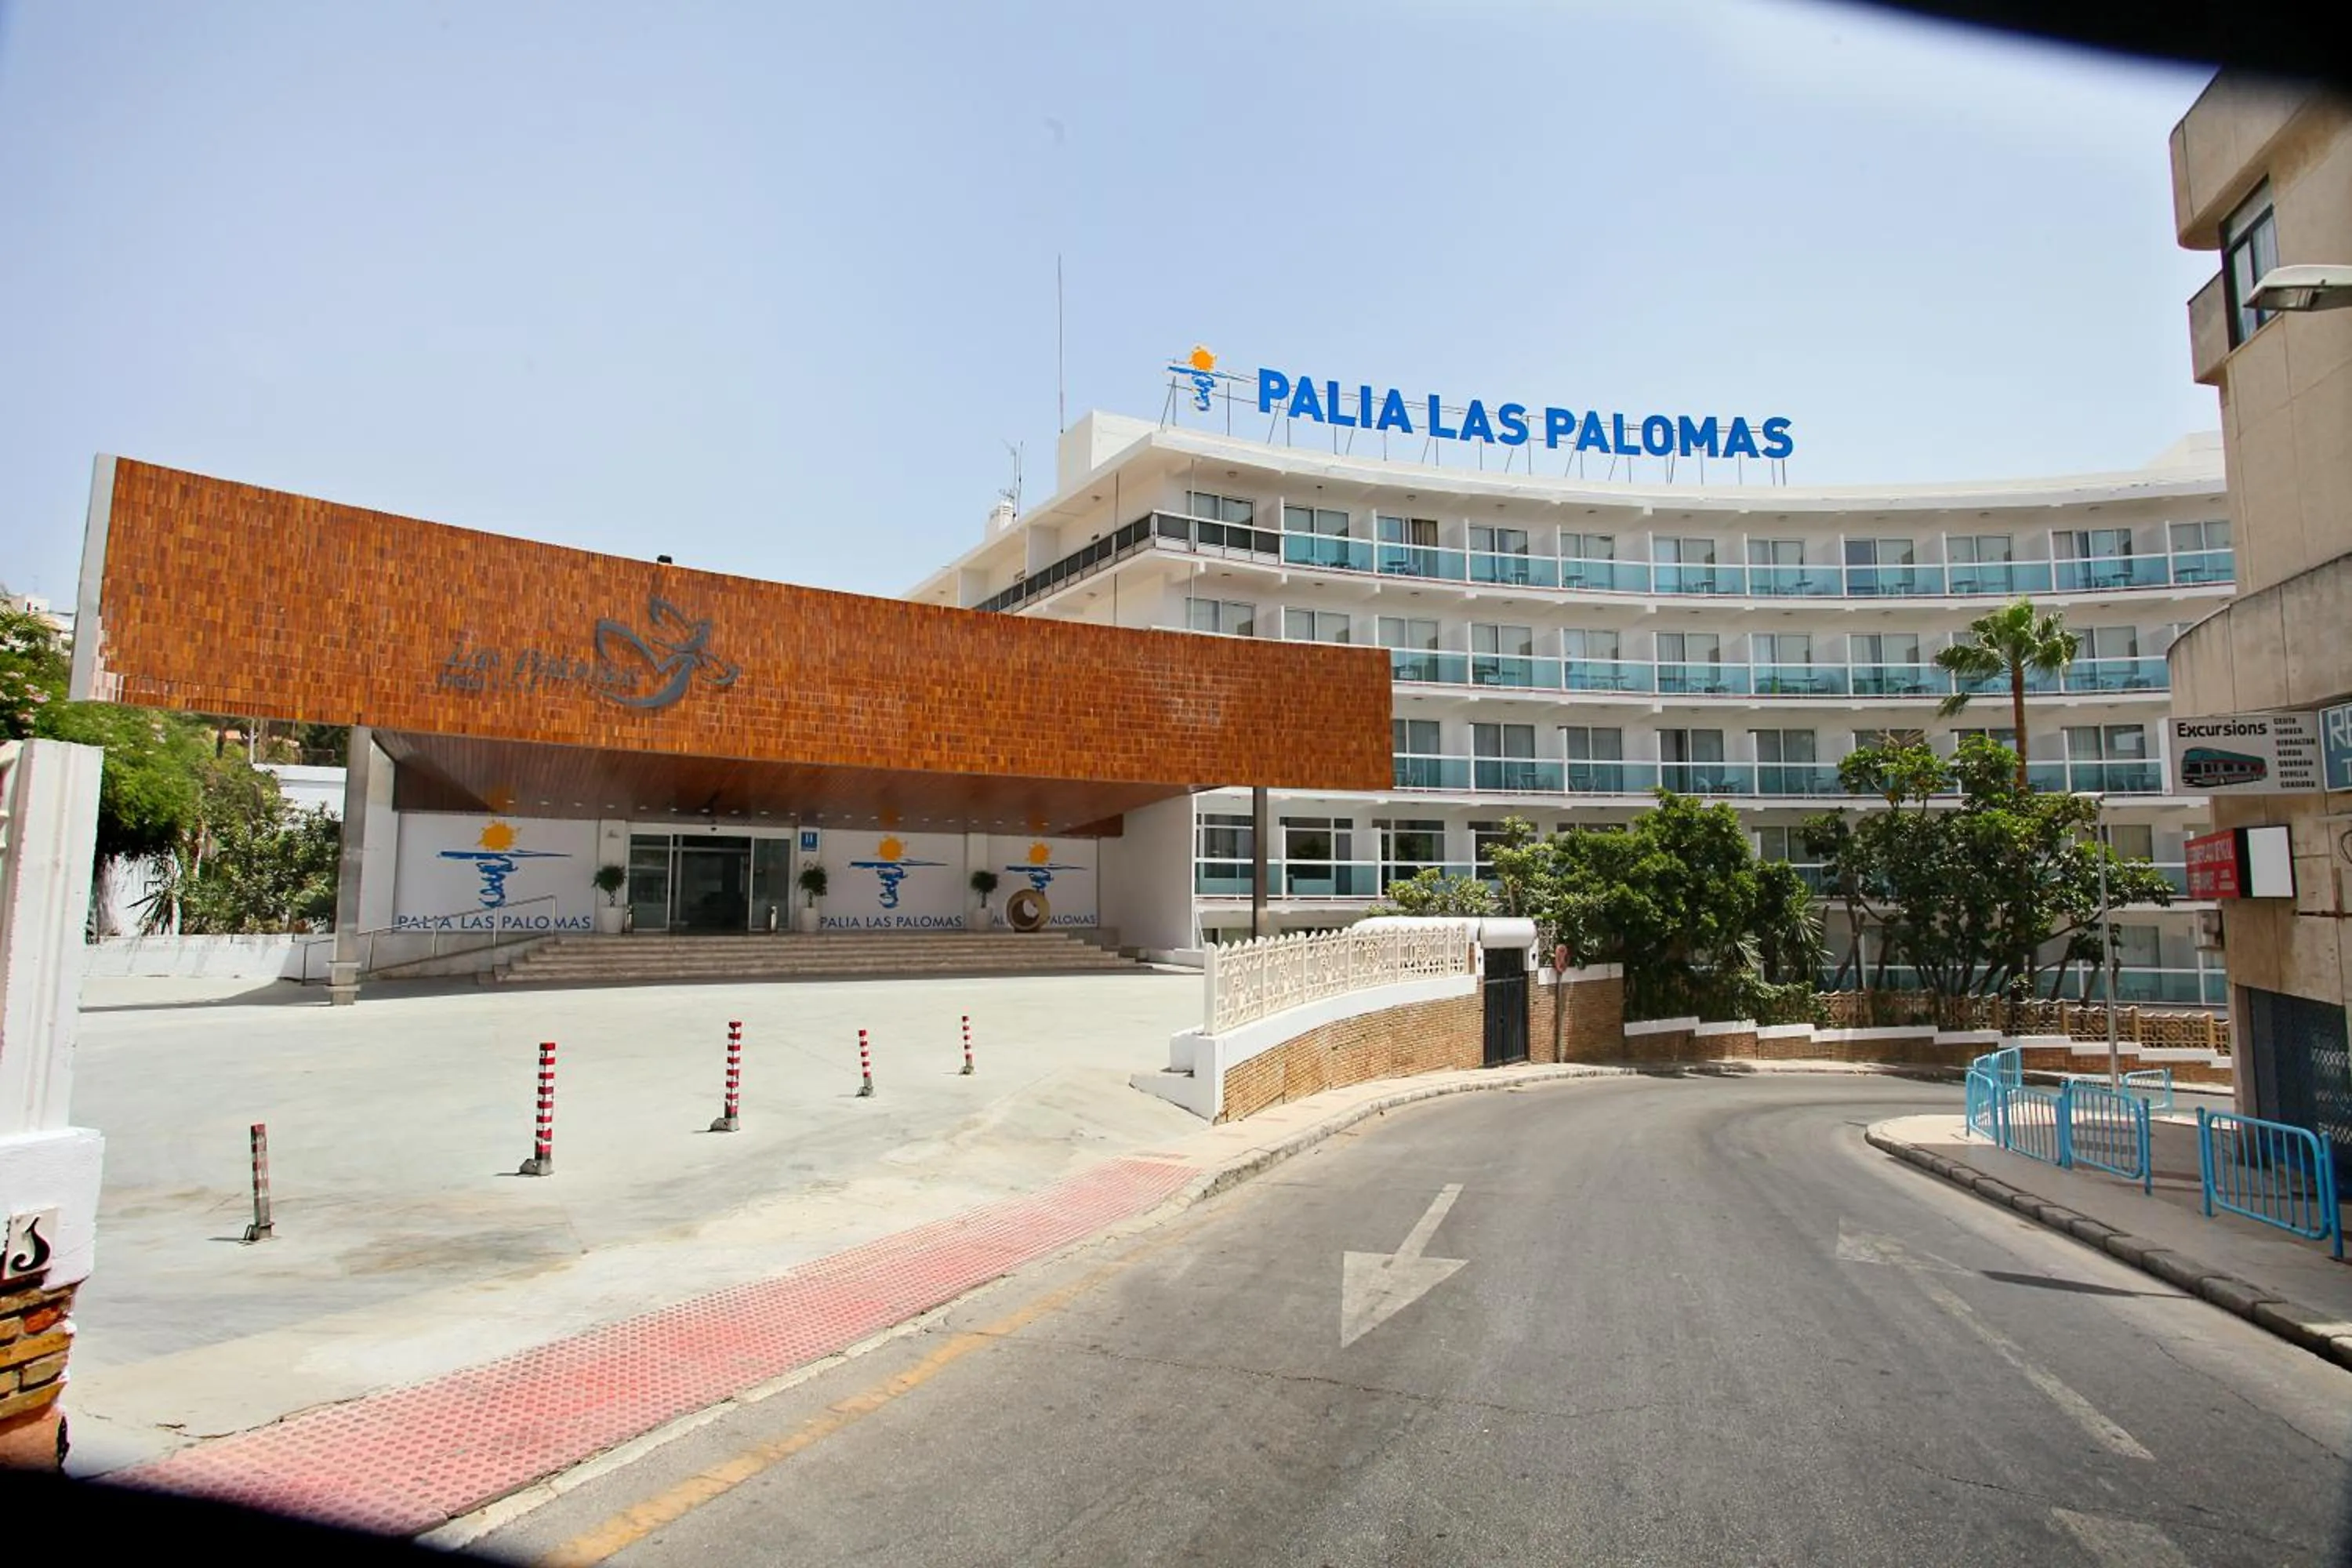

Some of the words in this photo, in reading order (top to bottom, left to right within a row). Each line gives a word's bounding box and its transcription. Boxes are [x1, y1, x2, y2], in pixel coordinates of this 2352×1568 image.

[1258, 367, 1414, 433] PALIA
[1428, 394, 1530, 446] LAS
[1544, 406, 1795, 459] PALOMAS
[2177, 719, 2267, 738] Excursions
[398, 915, 452, 929] PALA
[461, 915, 494, 929] LAS
[502, 915, 590, 929] PALOMAS
[820, 916, 861, 928] PALIA
[866, 916, 891, 928] LAS
[896, 915, 962, 927] PALOMAS
[1048, 914, 1095, 924] ALOMAS
